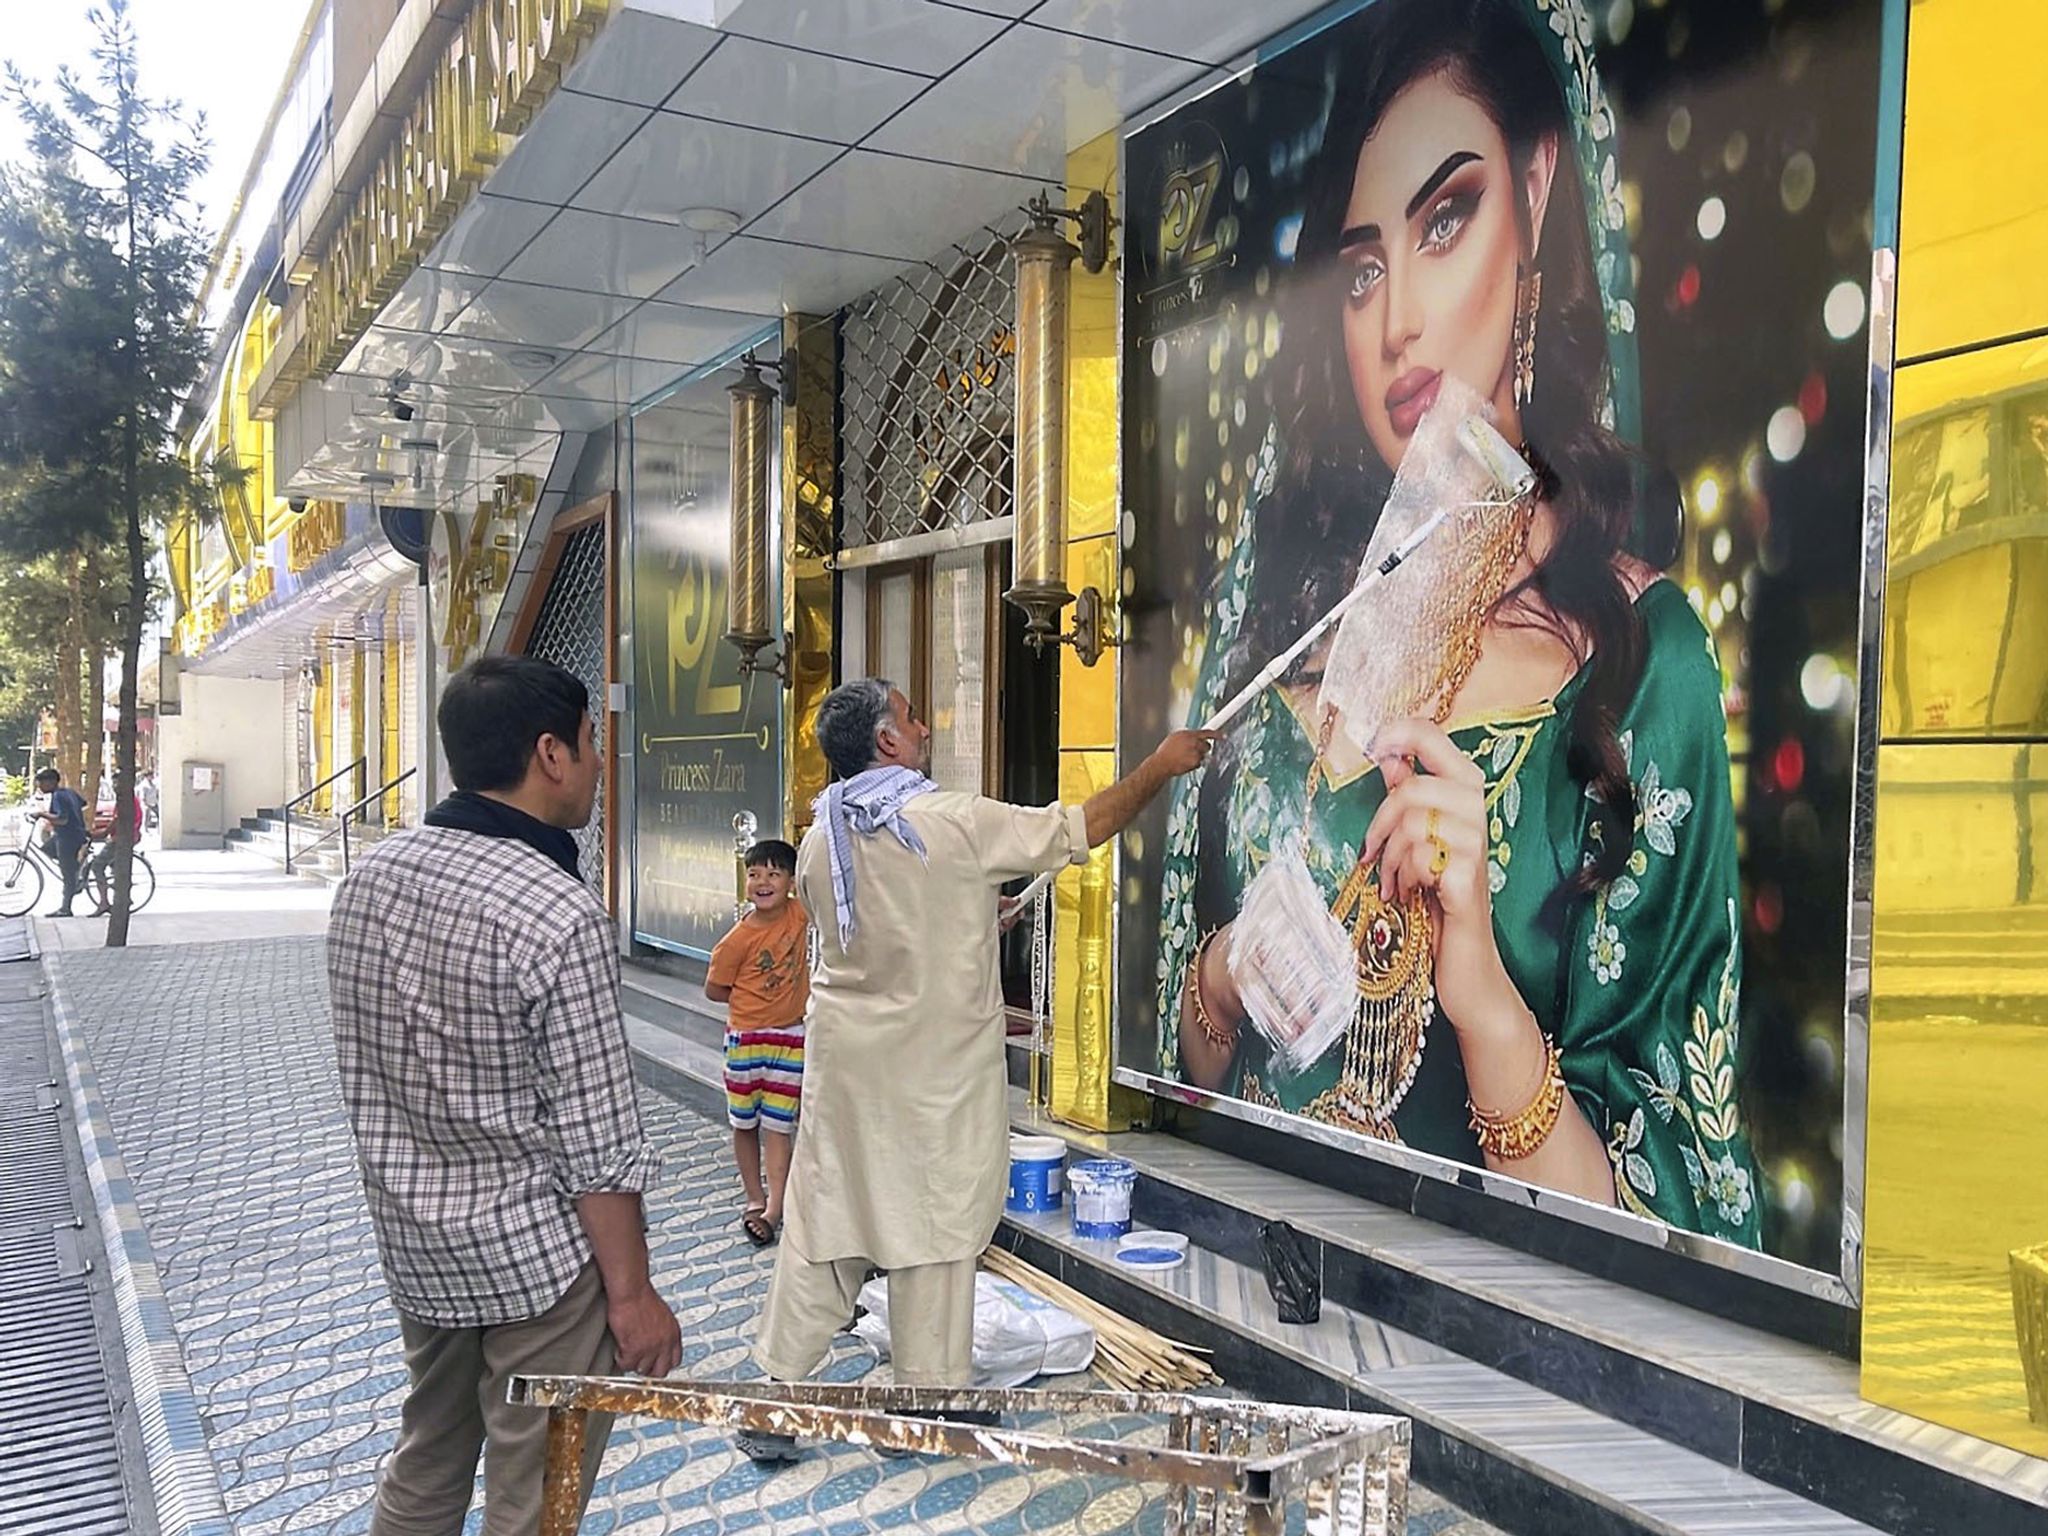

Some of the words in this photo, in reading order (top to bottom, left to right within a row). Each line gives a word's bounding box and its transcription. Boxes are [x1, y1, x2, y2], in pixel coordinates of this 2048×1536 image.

[400, 2, 480, 250] BEAUTY
[486, 0, 584, 131] SAL
[660, 751, 710, 791] Princess
[713, 749, 747, 792] Zara
